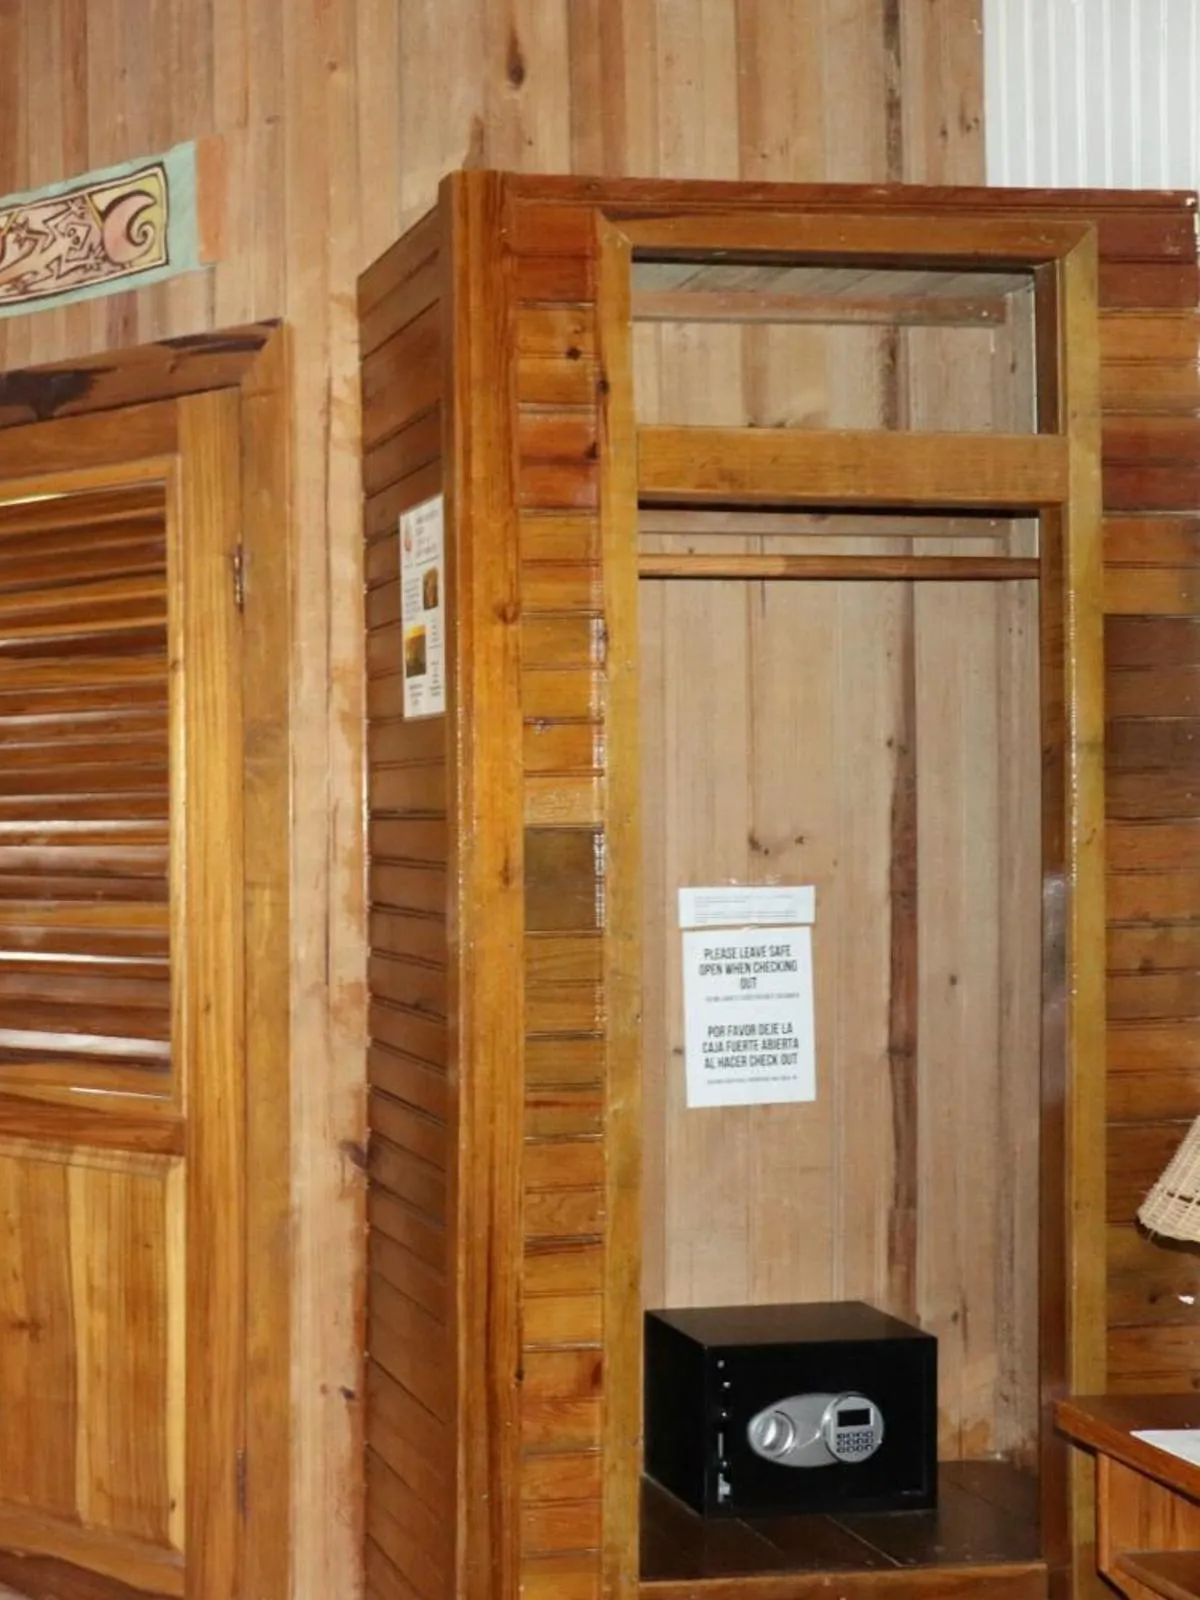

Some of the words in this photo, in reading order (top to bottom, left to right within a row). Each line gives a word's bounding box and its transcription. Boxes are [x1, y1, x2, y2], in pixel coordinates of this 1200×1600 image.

[704, 947, 736, 960] PLEASE
[741, 946, 767, 959] LEAVE
[769, 944, 791, 957] SAFE
[699, 963, 722, 976] OPEN
[726, 962, 751, 975] WHEN
[753, 960, 797, 973] CHECKING
[740, 976, 757, 989] OUT
[708, 1025, 725, 1037] POR
[727, 1024, 756, 1036] FAVOR
[758, 1023, 779, 1035] DEJE
[782, 1022, 793, 1034] LA
[702, 1041, 723, 1053] CAJA
[726, 1039, 759, 1052] FUERTE
[761, 1038, 799, 1050] ABIERTA
[704, 1057, 716, 1069] AL
[717, 1055, 747, 1068] HACER
[749, 1054, 778, 1067] CHECK
[780, 1053, 798, 1065] OUT
